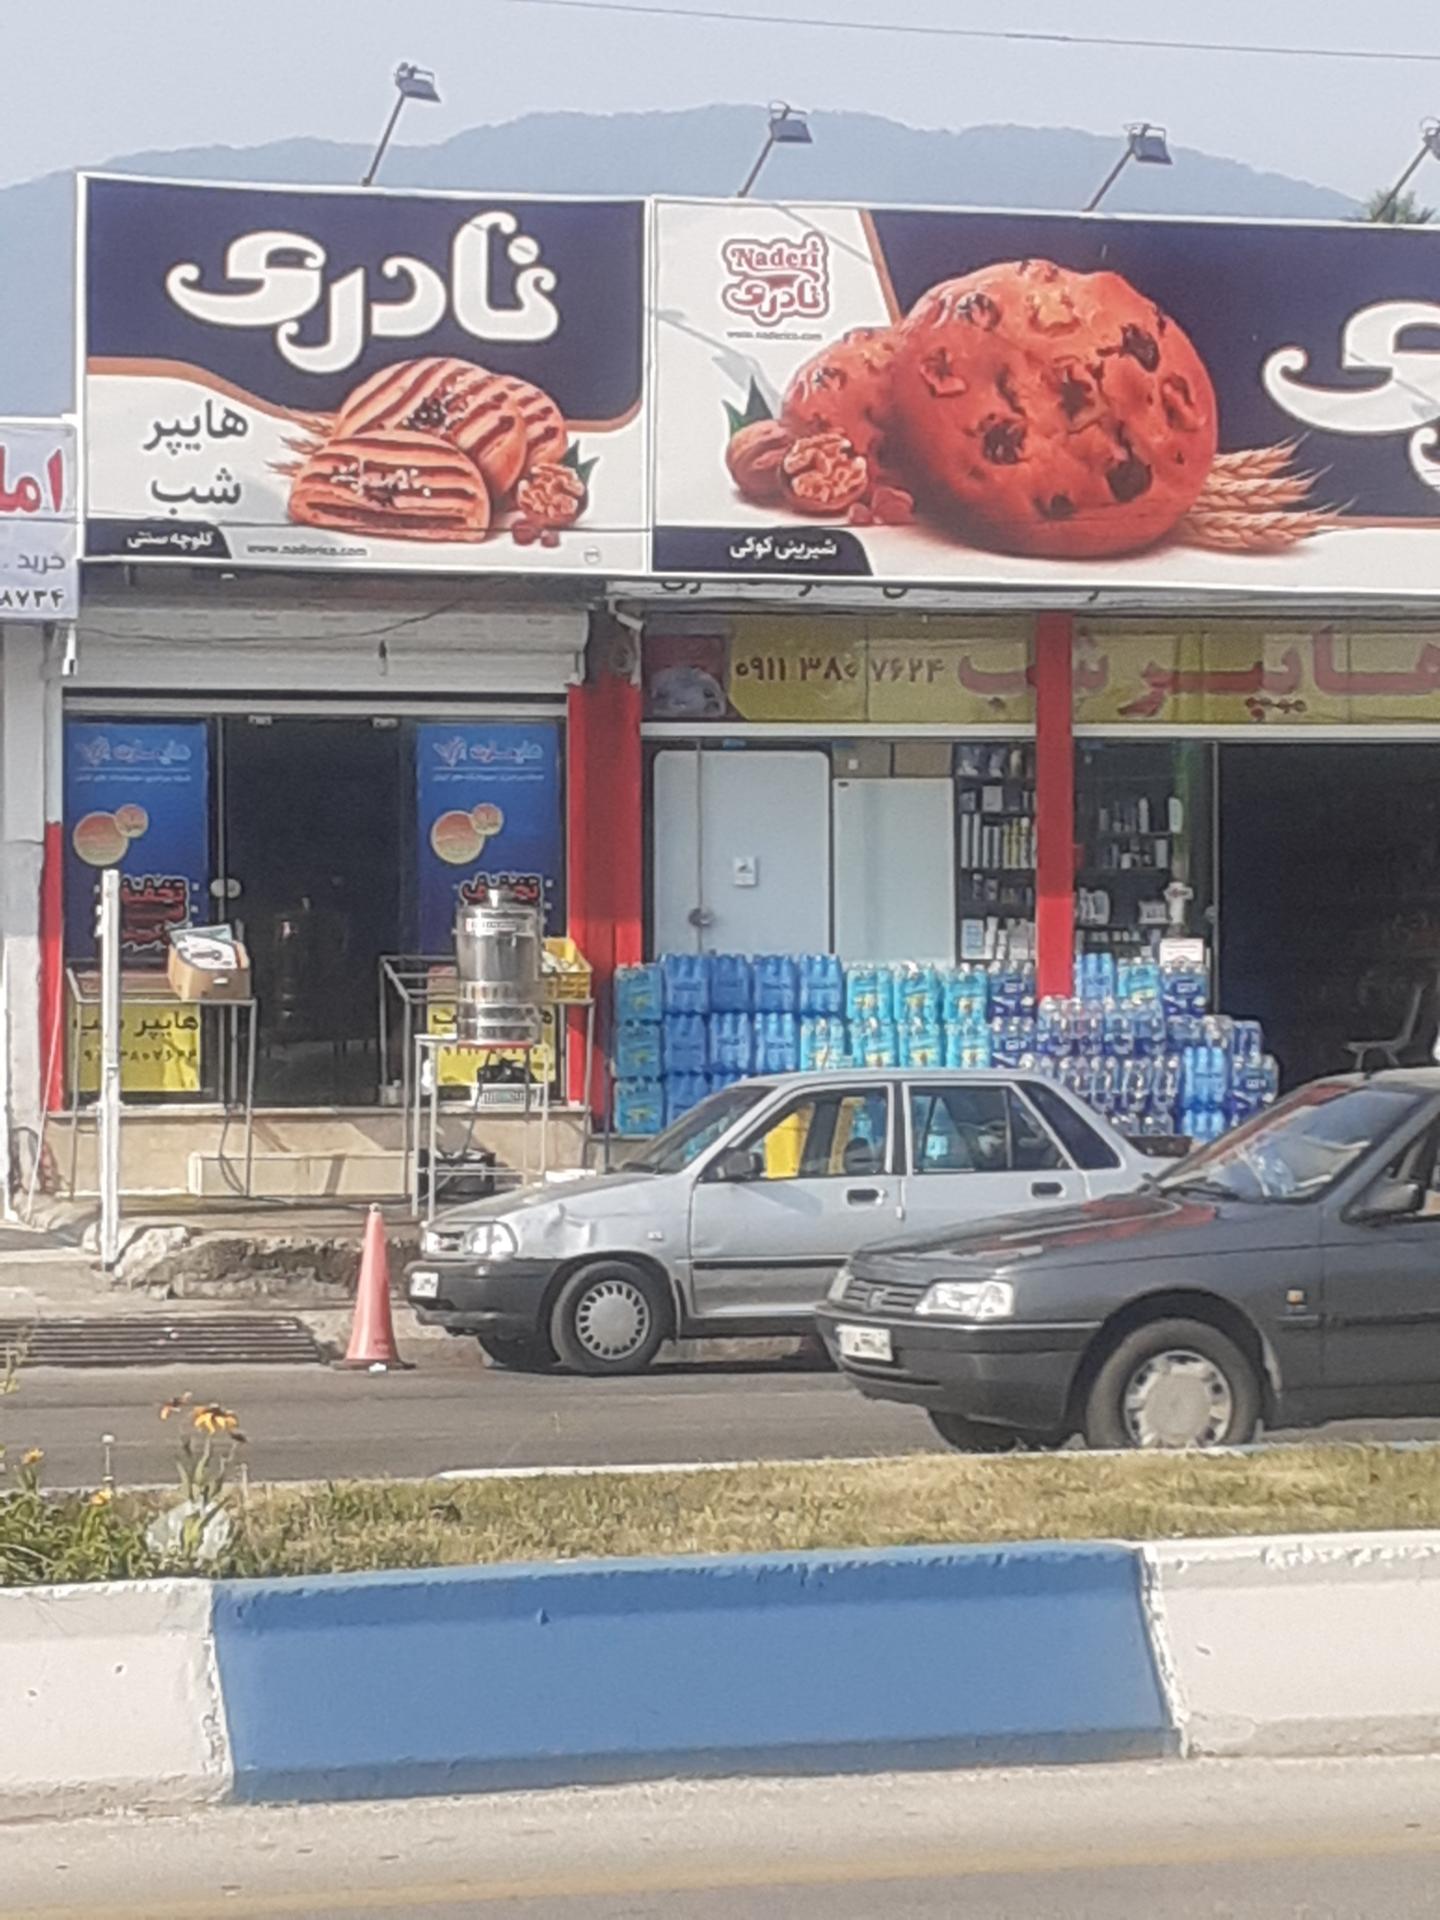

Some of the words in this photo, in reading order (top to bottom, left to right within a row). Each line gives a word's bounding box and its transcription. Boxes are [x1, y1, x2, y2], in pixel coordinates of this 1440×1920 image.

[730, 240, 821, 274] Naderi
[166, 212, 560, 372] نادری
[731, 279, 821, 318] نادری
[143, 400, 248, 454] هایپر
[151, 468, 242, 516] شب
[127, 531, 169, 548] سنتی
[169, 530, 214, 550] کلوچه
[729, 537, 773, 559] کوکی
[774, 538, 837, 559] شیرینی
[133, 1011, 198, 1039] هایپر
